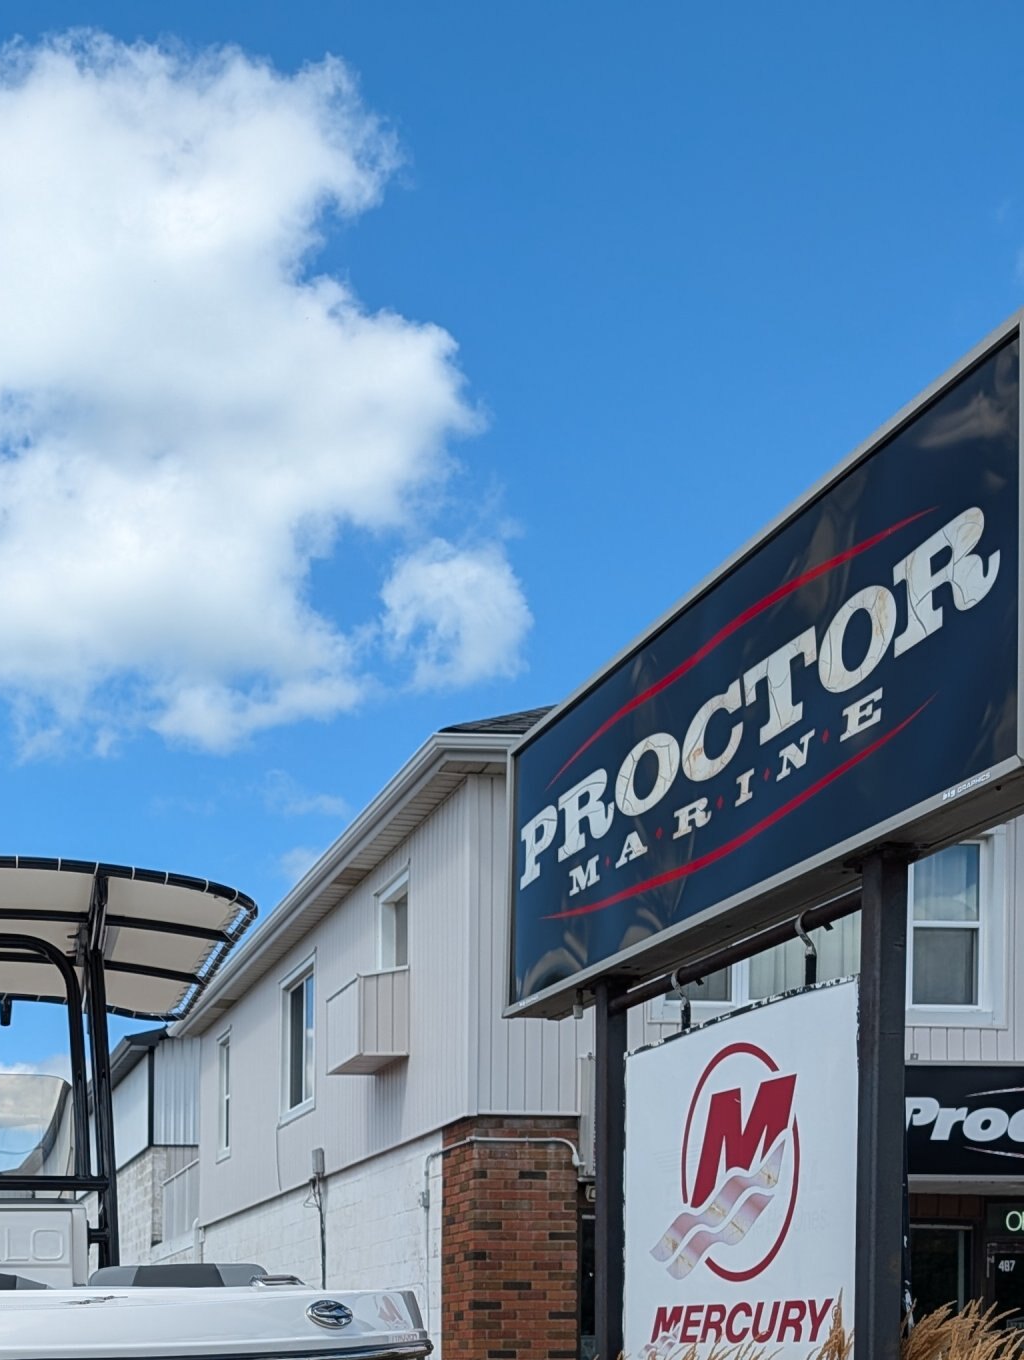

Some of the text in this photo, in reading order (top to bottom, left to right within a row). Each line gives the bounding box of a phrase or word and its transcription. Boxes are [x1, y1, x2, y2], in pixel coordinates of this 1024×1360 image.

[519, 506, 1002, 891] PROCTOR
[568, 687, 883, 897] MARINE
[1005, 1210, 1024, 1232] O
[650, 1298, 834, 1344] MERCURY
